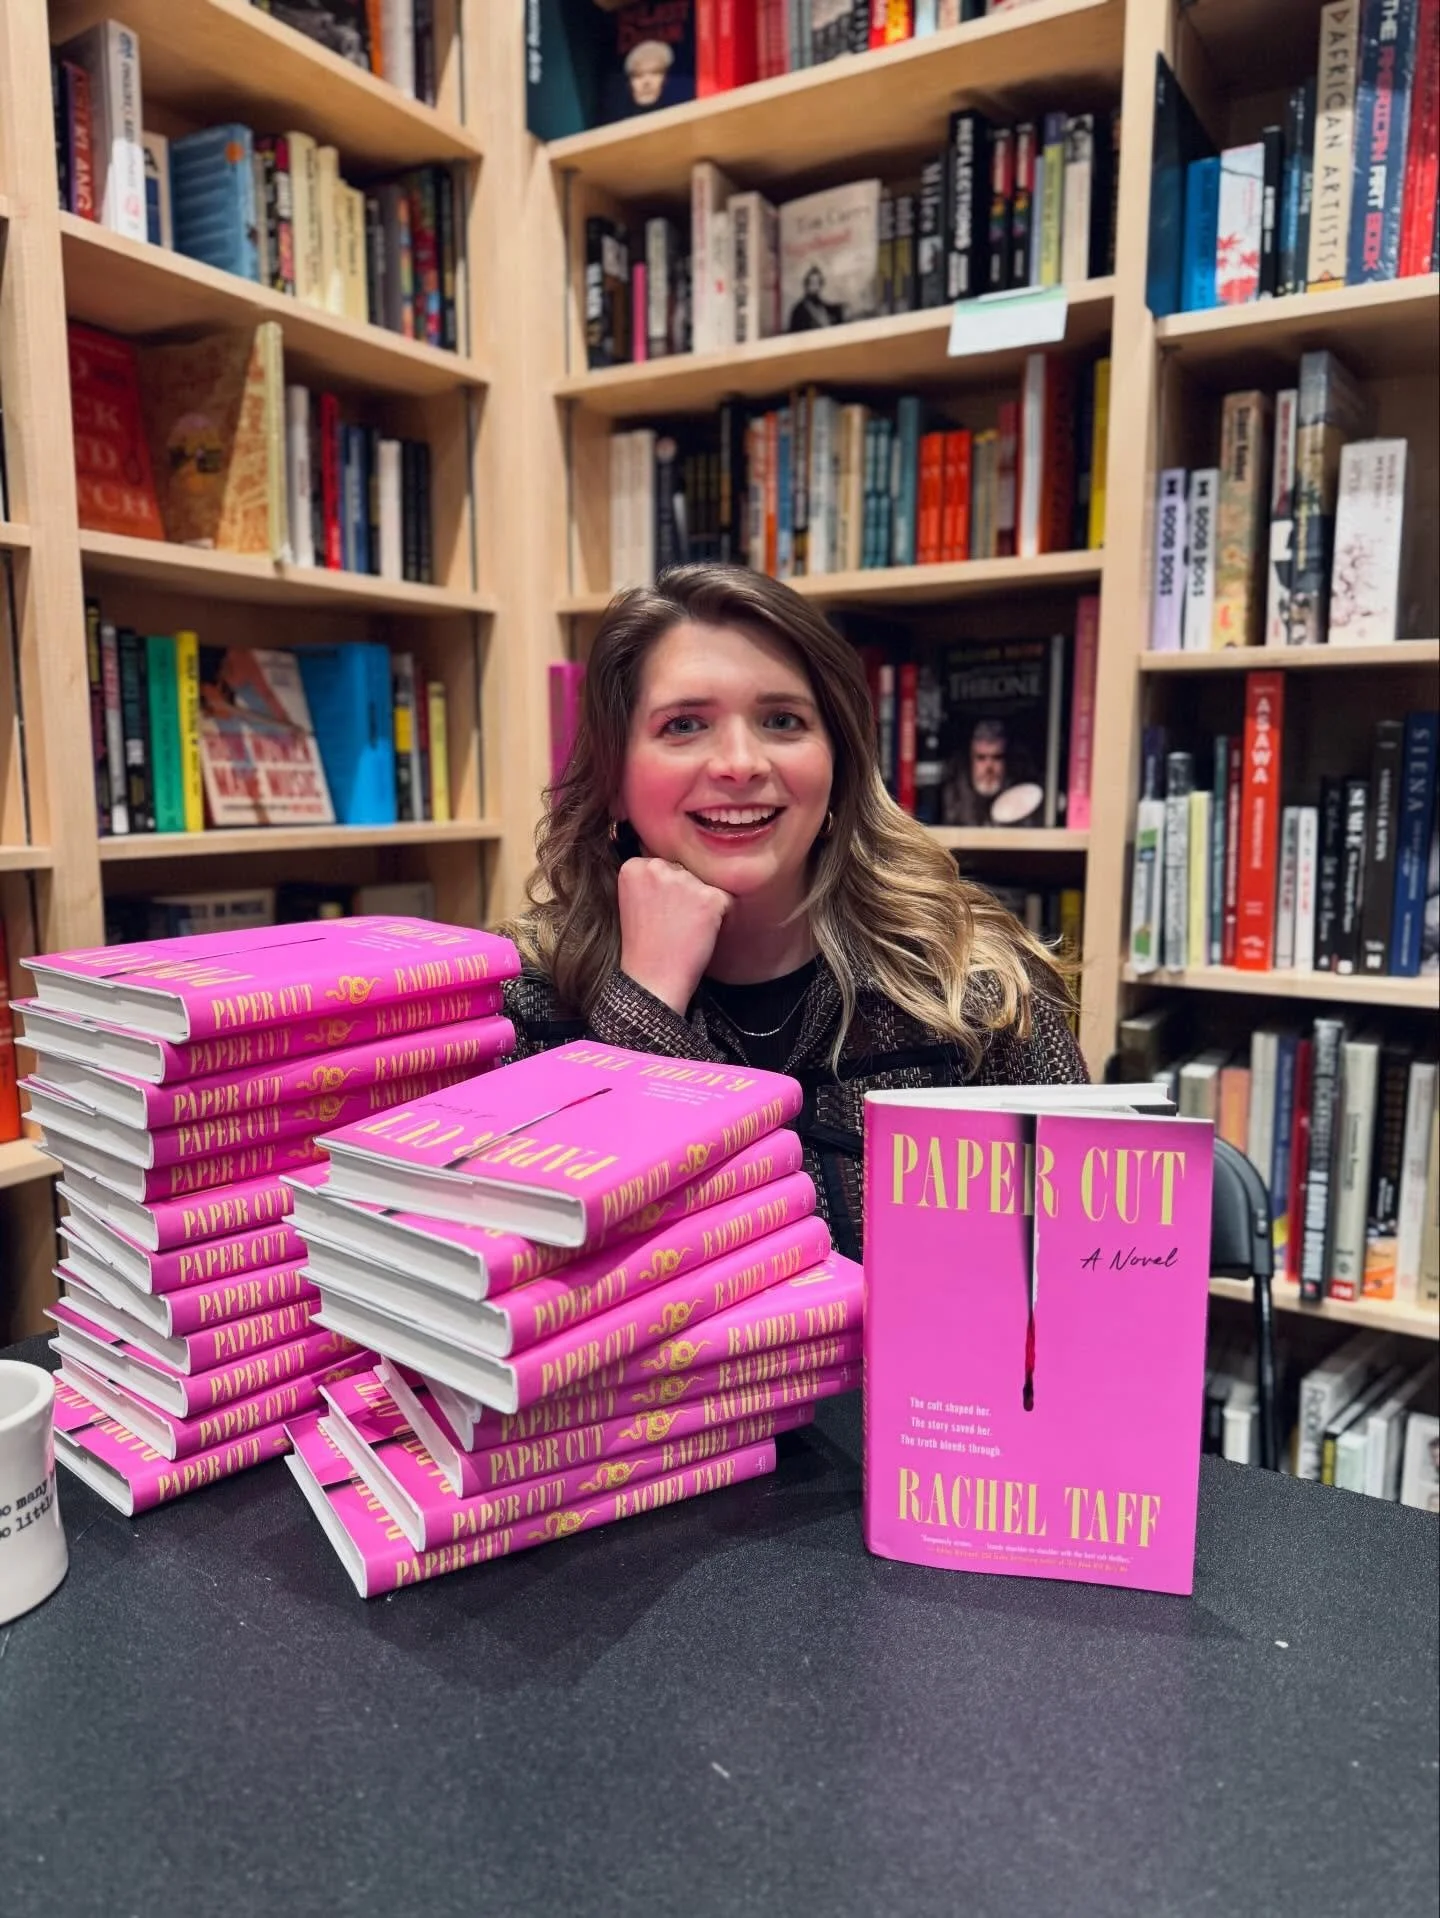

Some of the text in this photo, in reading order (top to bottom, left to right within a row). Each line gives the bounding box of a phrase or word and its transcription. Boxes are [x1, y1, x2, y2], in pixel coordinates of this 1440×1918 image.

[1317, 30, 1350, 264] AFRICAN ARTISTS
[953, 116, 974, 250] REFLECTIONS
[1252, 697, 1271, 784] ASAWA
[1407, 727, 1431, 812] SIENA
[211, 953, 489, 1030] PAPER CUT RACHEL TAFF
[190, 993, 472, 1075] PAPER CUT RACHEL TAFF
[173, 1039, 481, 1123] PAPER CUT RACHEL TAFF
[177, 1115, 242, 1157] PAPER
[247, 1107, 283, 1139] CUT
[602, 1176, 645, 1226] PAPER
[722, 1111, 760, 1153] RACHEL
[761, 1097, 784, 1124] TAFF
[171, 1145, 277, 1194] PAPER CUT
[684, 1169, 737, 1213] RACHEL
[742, 1155, 774, 1184] TAFF
[889, 1133, 1187, 1226] PAPER CUT
[182, 1187, 294, 1240] PAPER CUT
[179, 1230, 289, 1284] PAPER CUT
[534, 1196, 789, 1339] PAPER CUT RACHEL TAFF
[1081, 1246, 1179, 1271] A Novel
[199, 1270, 303, 1324] PAPER CUT
[213, 1300, 313, 1360] PAPER CUT
[542, 1340, 600, 1397] PAPER
[604, 1321, 638, 1363] CUT
[714, 1263, 766, 1309] RACHEL
[771, 1245, 801, 1281] TAFF
[727, 1300, 848, 1356] RACHEL TAFF
[210, 1343, 307, 1404] PAPER CUT
[501, 1337, 841, 1444] PAPER CUT RACHEL TAFF
[909, 1396, 924, 1409] The
[944, 1402, 974, 1416] shaped
[976, 1406, 992, 1417] her.
[200, 1405, 260, 1448] PAPER
[264, 1386, 301, 1419] CUT
[489, 1374, 821, 1485] PAPER CUT RACHEL TAFF
[899, 1433, 915, 1446] The
[917, 1438, 938, 1449] truth
[940, 1440, 966, 1453] bleeds
[911, 1416, 925, 1428] The
[927, 1420, 949, 1433] story
[951, 1424, 975, 1435] saved
[15, 1478, 48, 1511] many
[157, 1437, 262, 1502] PAPER CUT
[452, 1412, 776, 1540] PAPER CUT RACHEL TAFF
[395, 1458, 737, 1587] PAPER CUT RACHEL TAFF
[897, 1467, 1162, 1548] RACHEL TAFF
